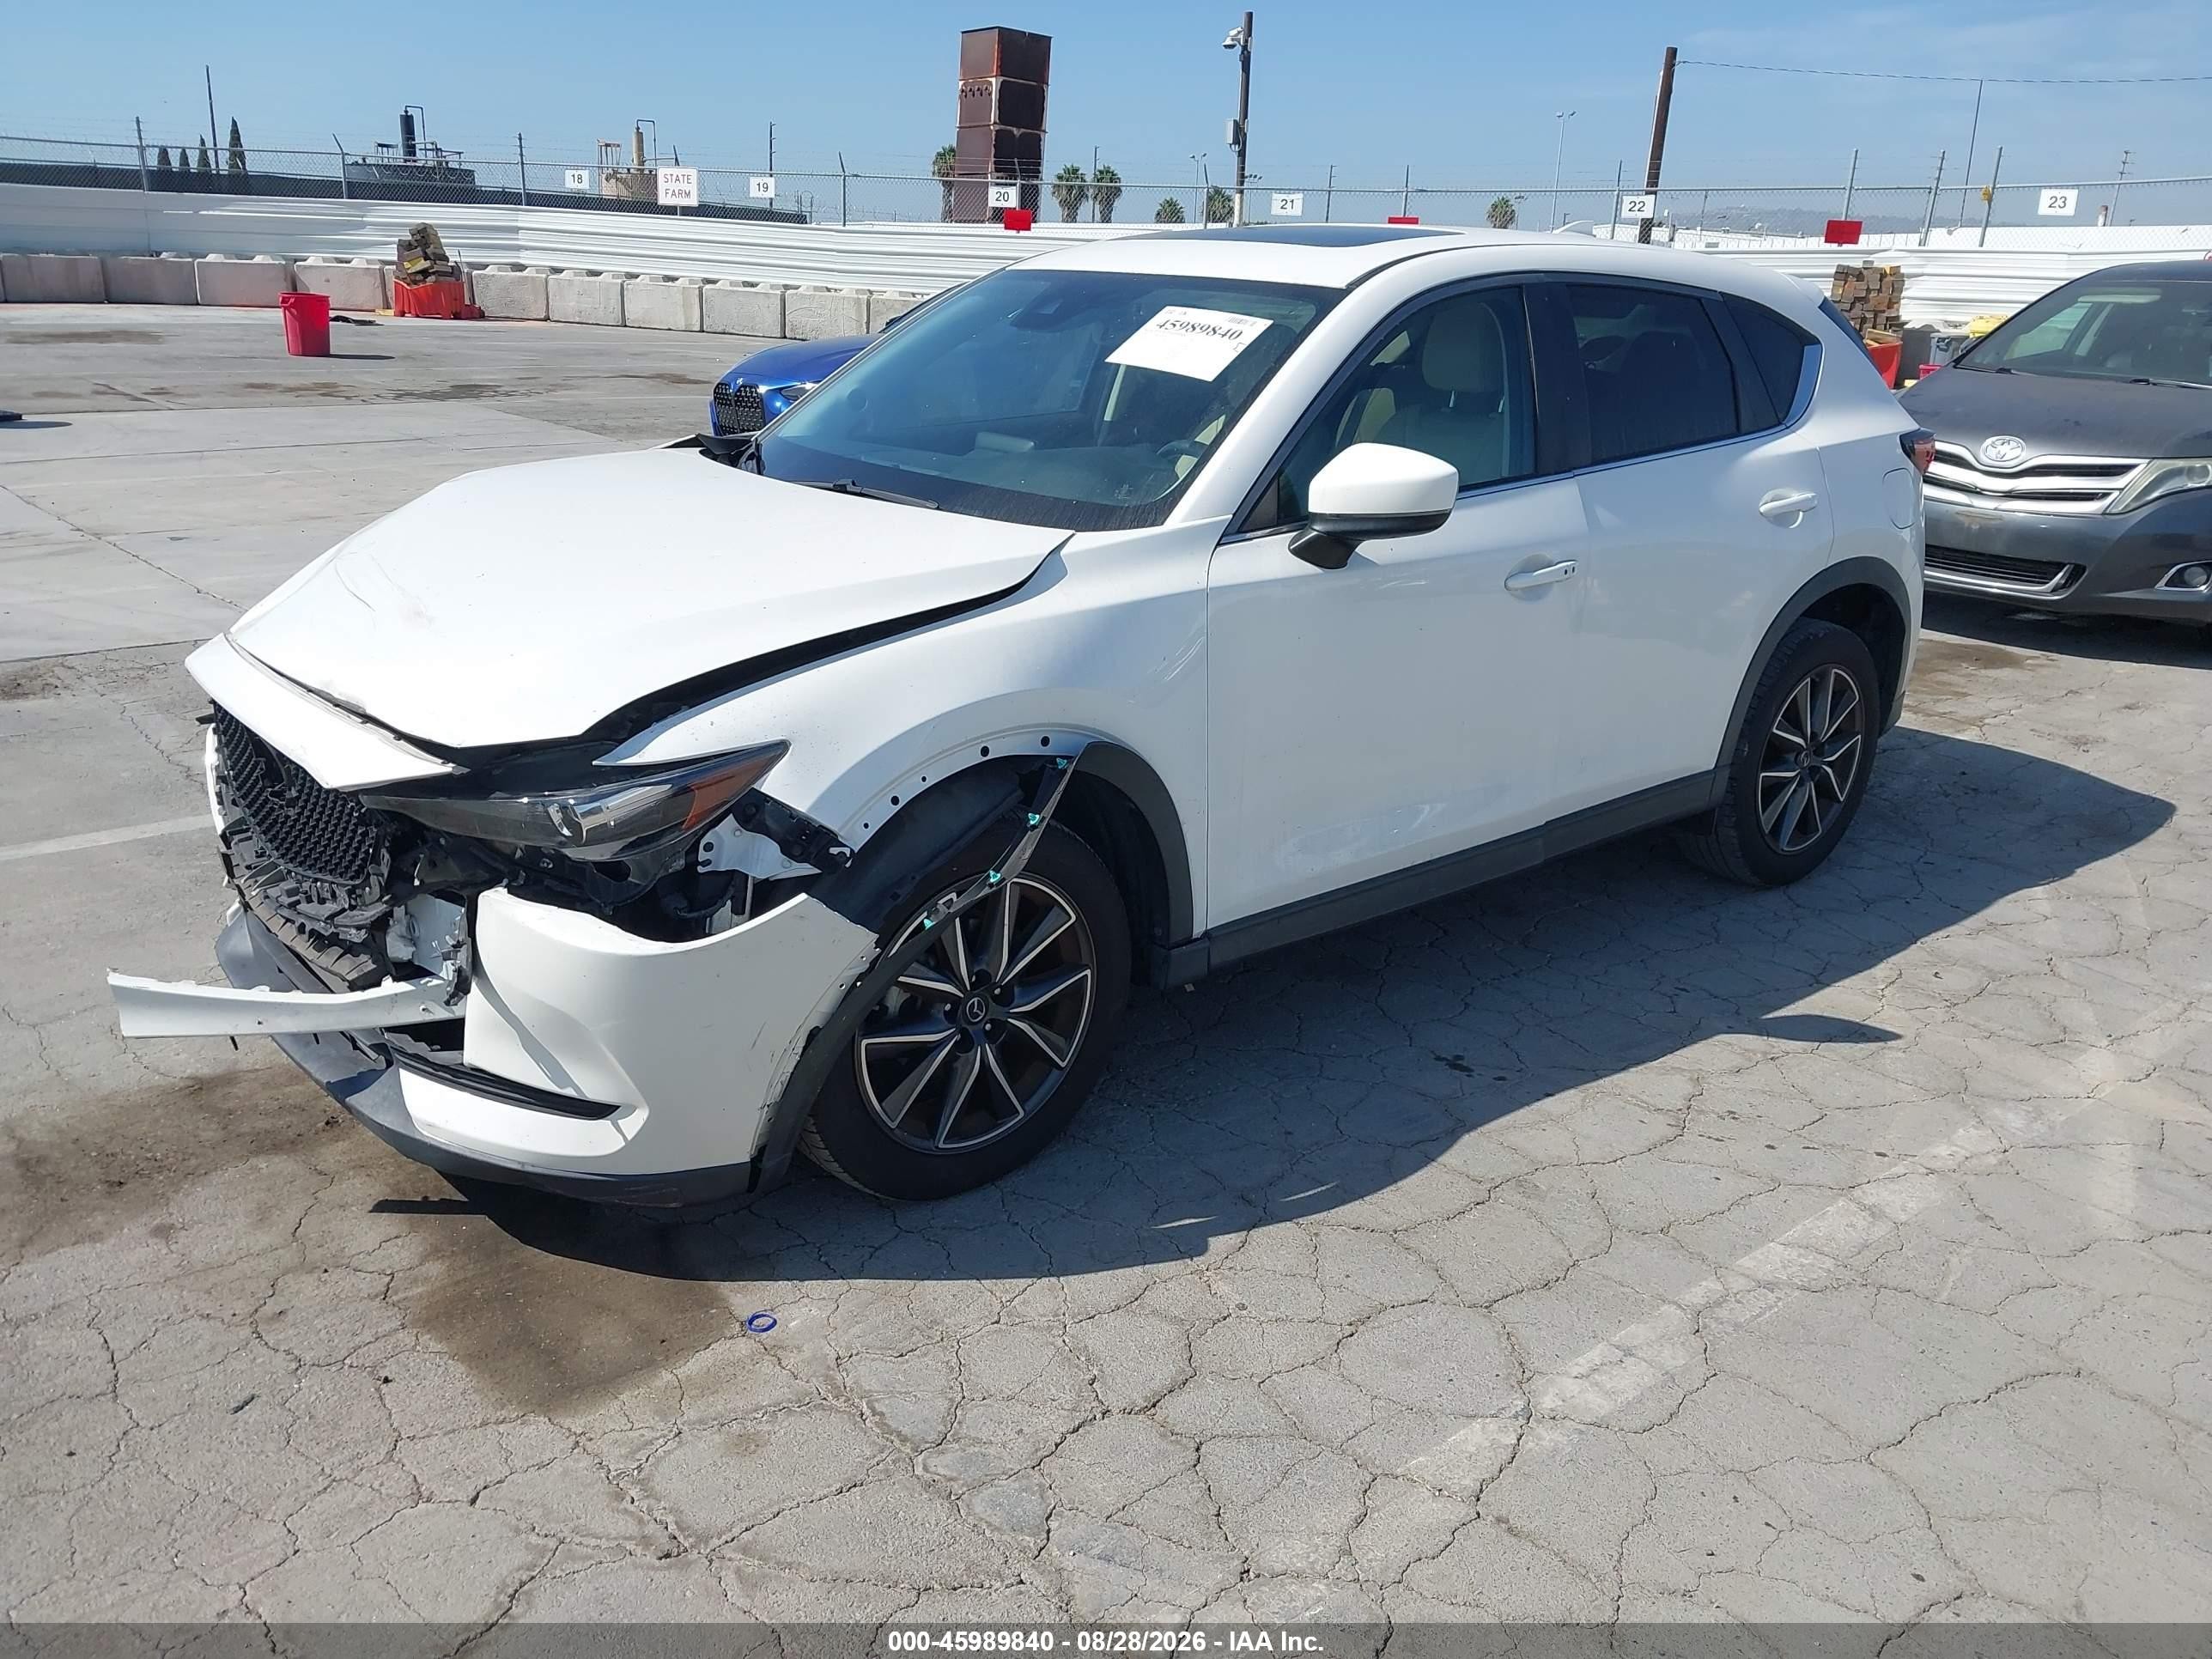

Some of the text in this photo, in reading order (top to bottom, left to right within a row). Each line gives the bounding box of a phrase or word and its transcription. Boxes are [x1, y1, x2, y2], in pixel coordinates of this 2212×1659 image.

[571, 173, 584, 185] 18
[663, 173, 692, 185] STATE
[756, 181, 769, 193] 19
[665, 189, 691, 200] FARM
[995, 191, 1010, 202] 20
[1279, 198, 1295, 210] 21
[1627, 200, 1646, 212] 22
[2047, 195, 2068, 209] 23
[1156, 319, 1243, 341] 45989840
